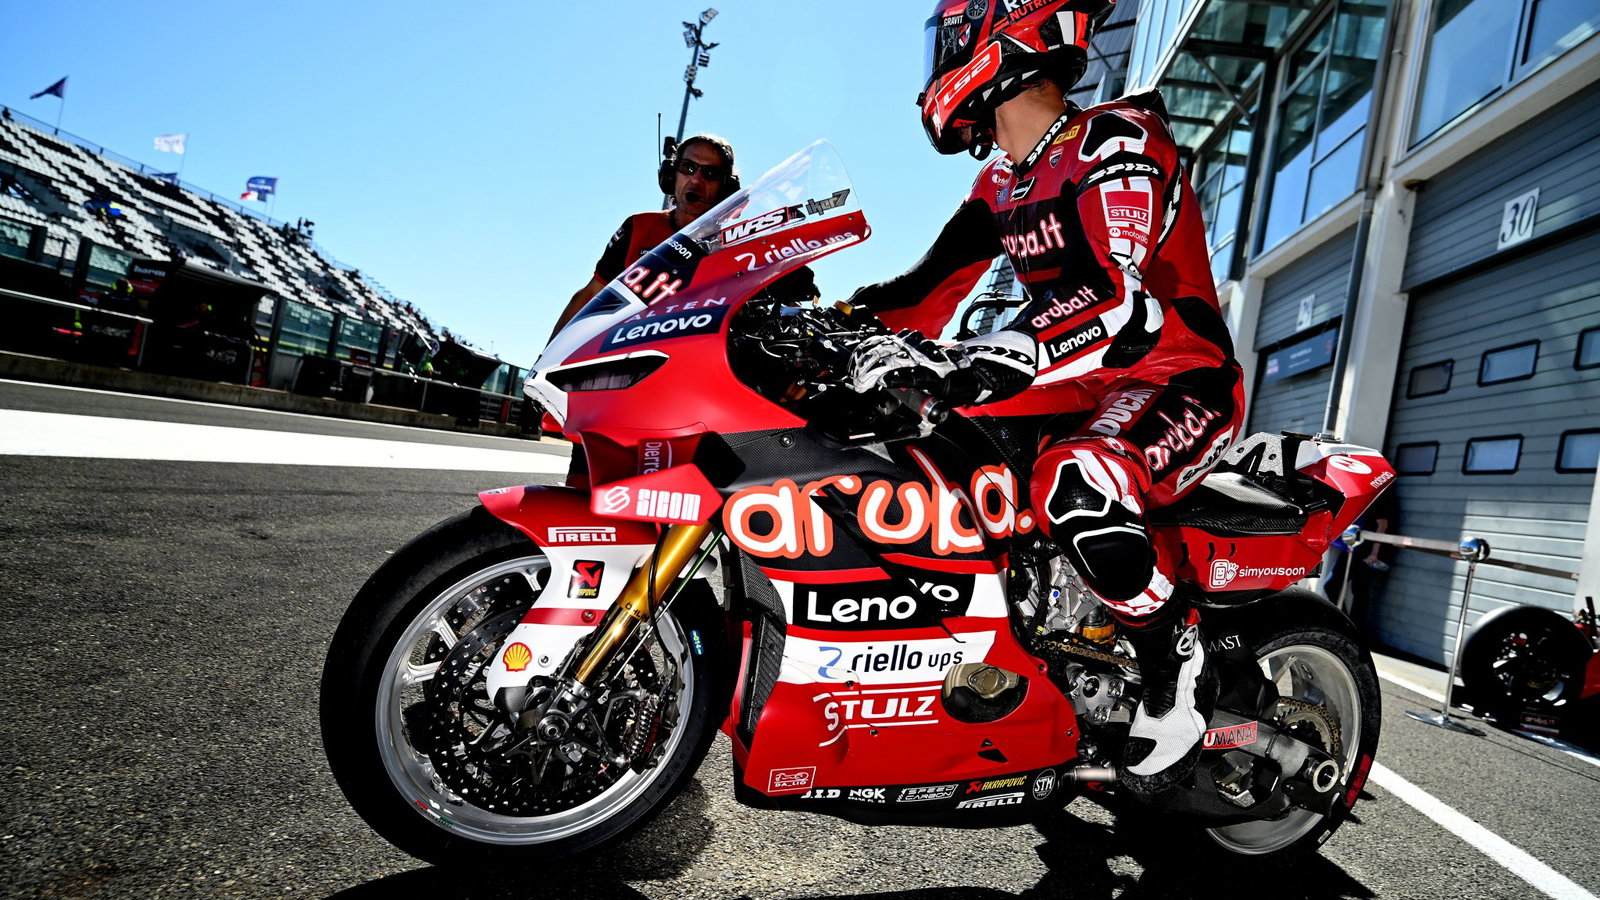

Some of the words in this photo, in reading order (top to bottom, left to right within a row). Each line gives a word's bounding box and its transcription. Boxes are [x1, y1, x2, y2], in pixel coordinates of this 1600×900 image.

[943, 53, 991, 106] LS2
[1087, 162, 1159, 184] SPIDI
[724, 209, 785, 243] WRS
[1111, 208, 1148, 222] STULZ
[1501, 195, 1536, 243] 30
[764, 238, 823, 264] riello
[624, 297, 727, 323] ALTEN
[1031, 286, 1099, 328] aruba.it
[611, 314, 713, 344] Lenovo
[1050, 325, 1102, 358] Lenovo
[636, 488, 701, 521] SICOM
[547, 526, 617, 543] PIRELLI
[1239, 566, 1306, 578] simyousoon
[807, 577, 960, 623] Lenovo
[847, 644, 923, 673] riello
[927, 650, 964, 671] ups
[824, 695, 936, 731] STULZ
[1203, 727, 1254, 748] UMANA
[849, 788, 886, 799] NGK
[907, 785, 955, 795] SPEED
[1034, 776, 1053, 792] STM
[955, 791, 1026, 809] PIRELLI
